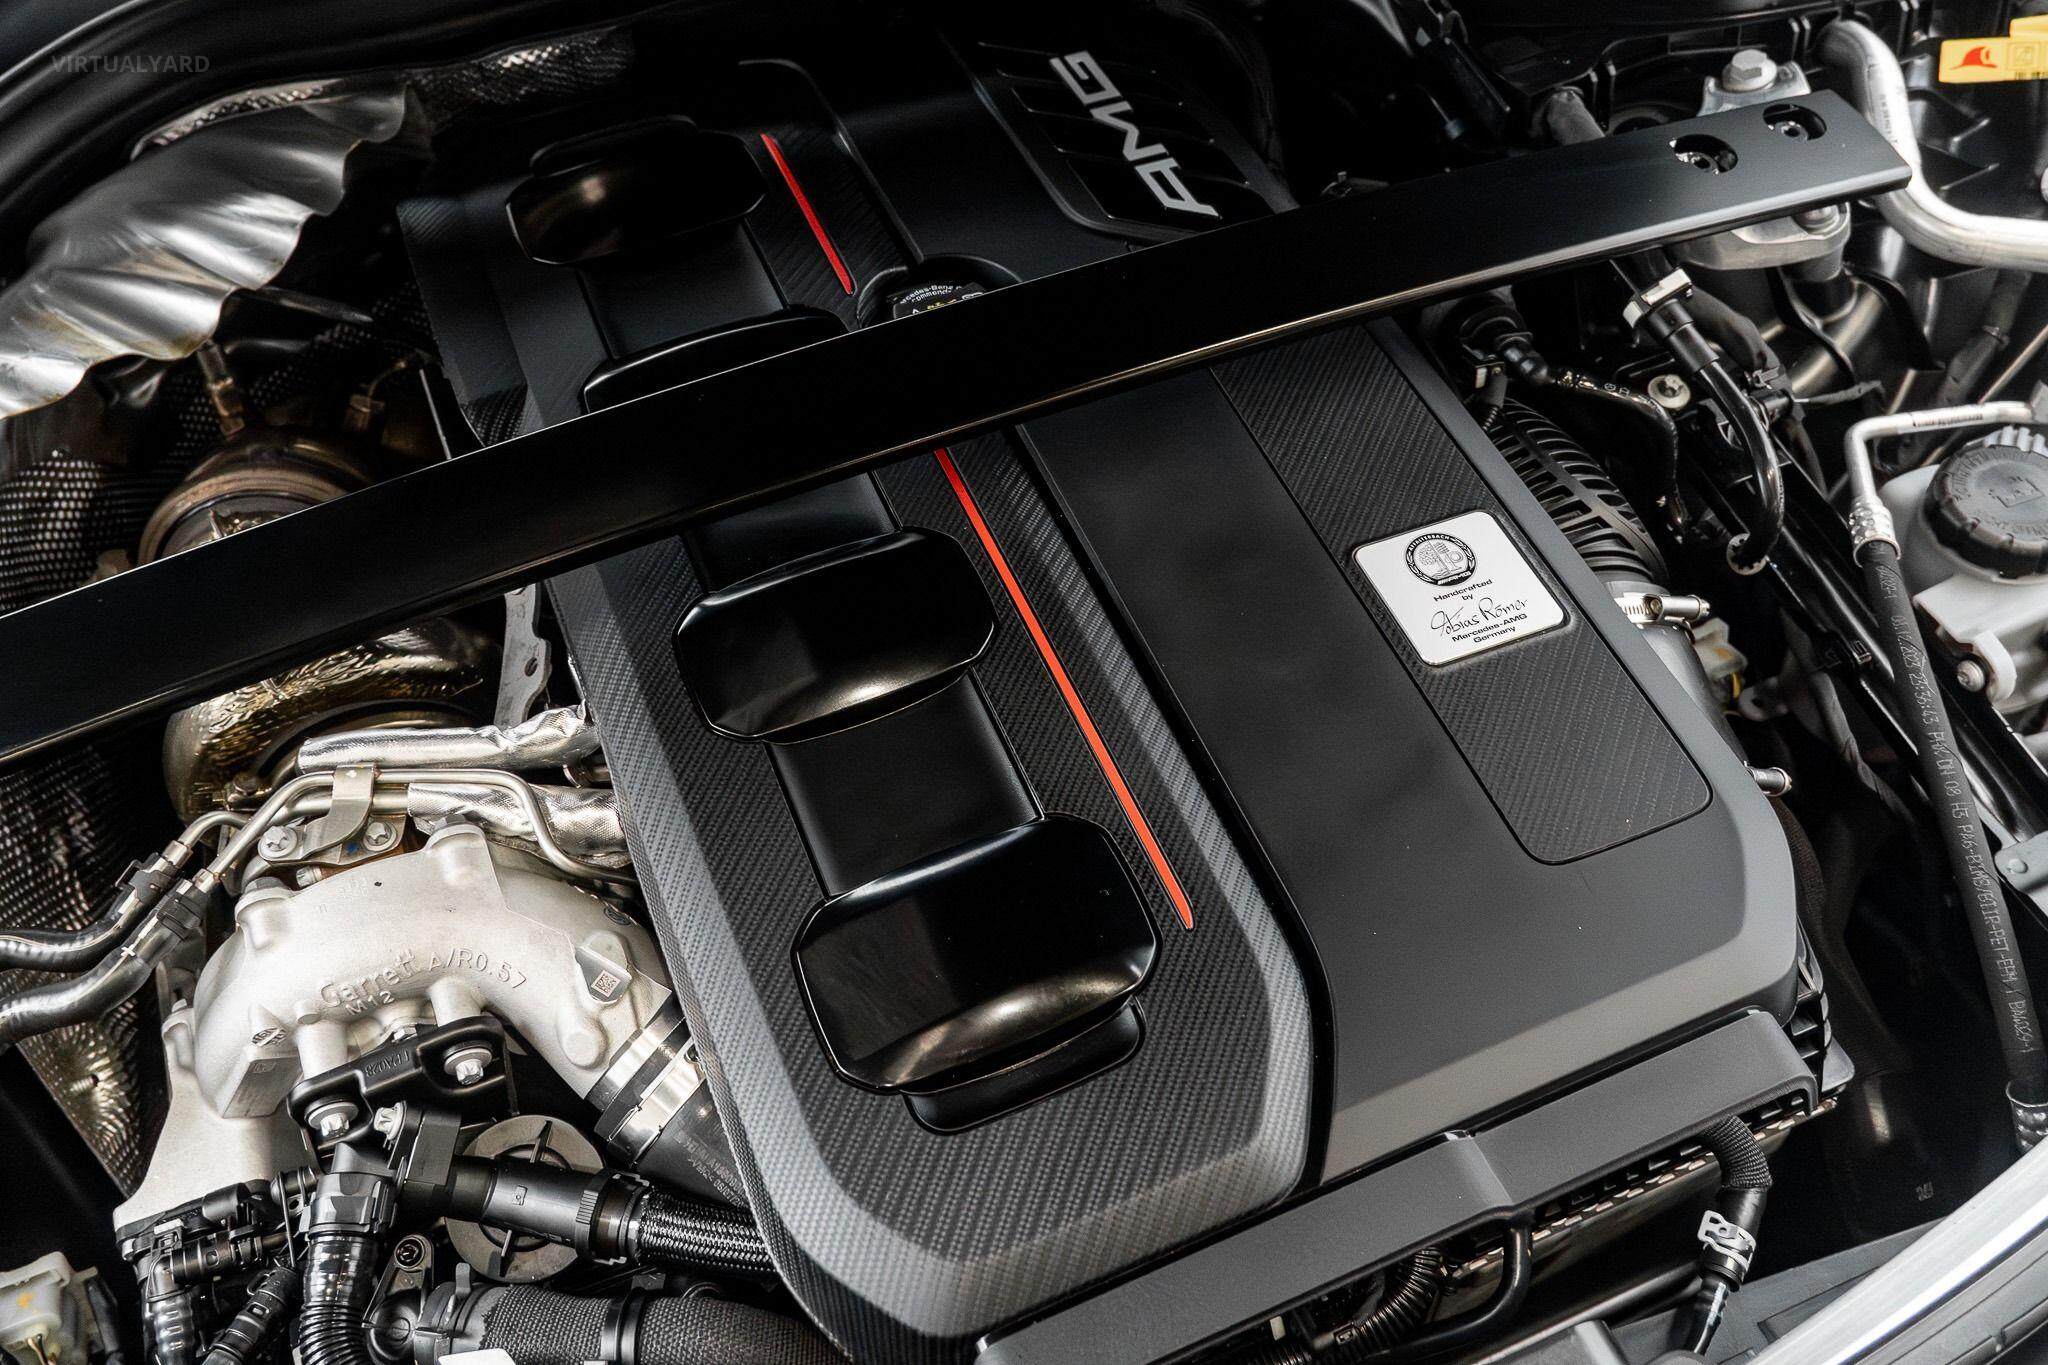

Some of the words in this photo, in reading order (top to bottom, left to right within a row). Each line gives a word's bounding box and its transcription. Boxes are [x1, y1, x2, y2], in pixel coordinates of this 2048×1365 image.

[1049, 50, 1222, 218] AMG
[1433, 579, 1493, 601] Handcrafted
[1452, 613, 1528, 642] Mercedes-AMG
[1473, 626, 1516, 643] Germany
